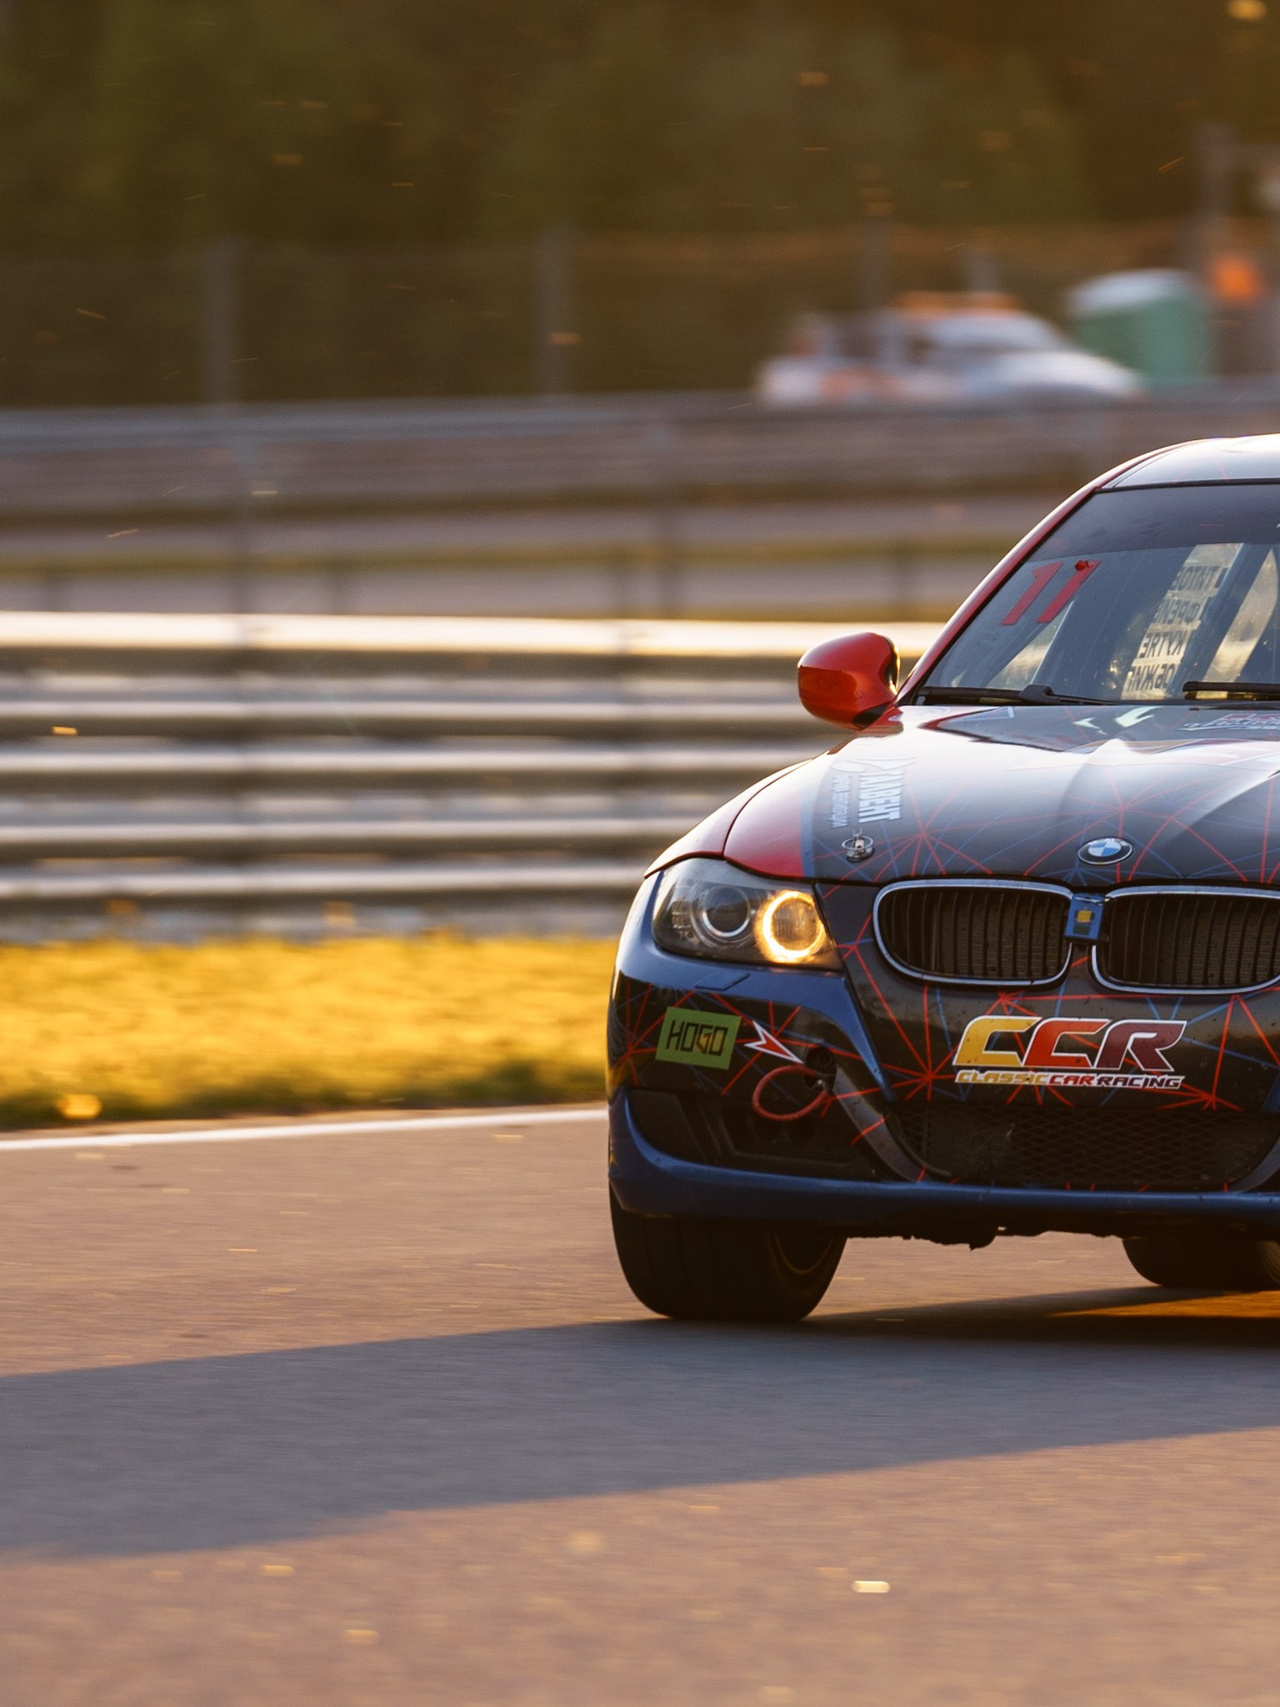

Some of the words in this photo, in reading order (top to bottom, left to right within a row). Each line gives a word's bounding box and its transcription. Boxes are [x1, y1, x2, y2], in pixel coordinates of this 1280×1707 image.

[1000, 559, 1101, 626] 11
[665, 1019, 729, 1057] HOGO
[952, 1015, 1187, 1071] CCR
[955, 1070, 1051, 1085] CLASSIC
[1050, 1073, 1095, 1087] CAR
[1097, 1075, 1187, 1090] RACING
